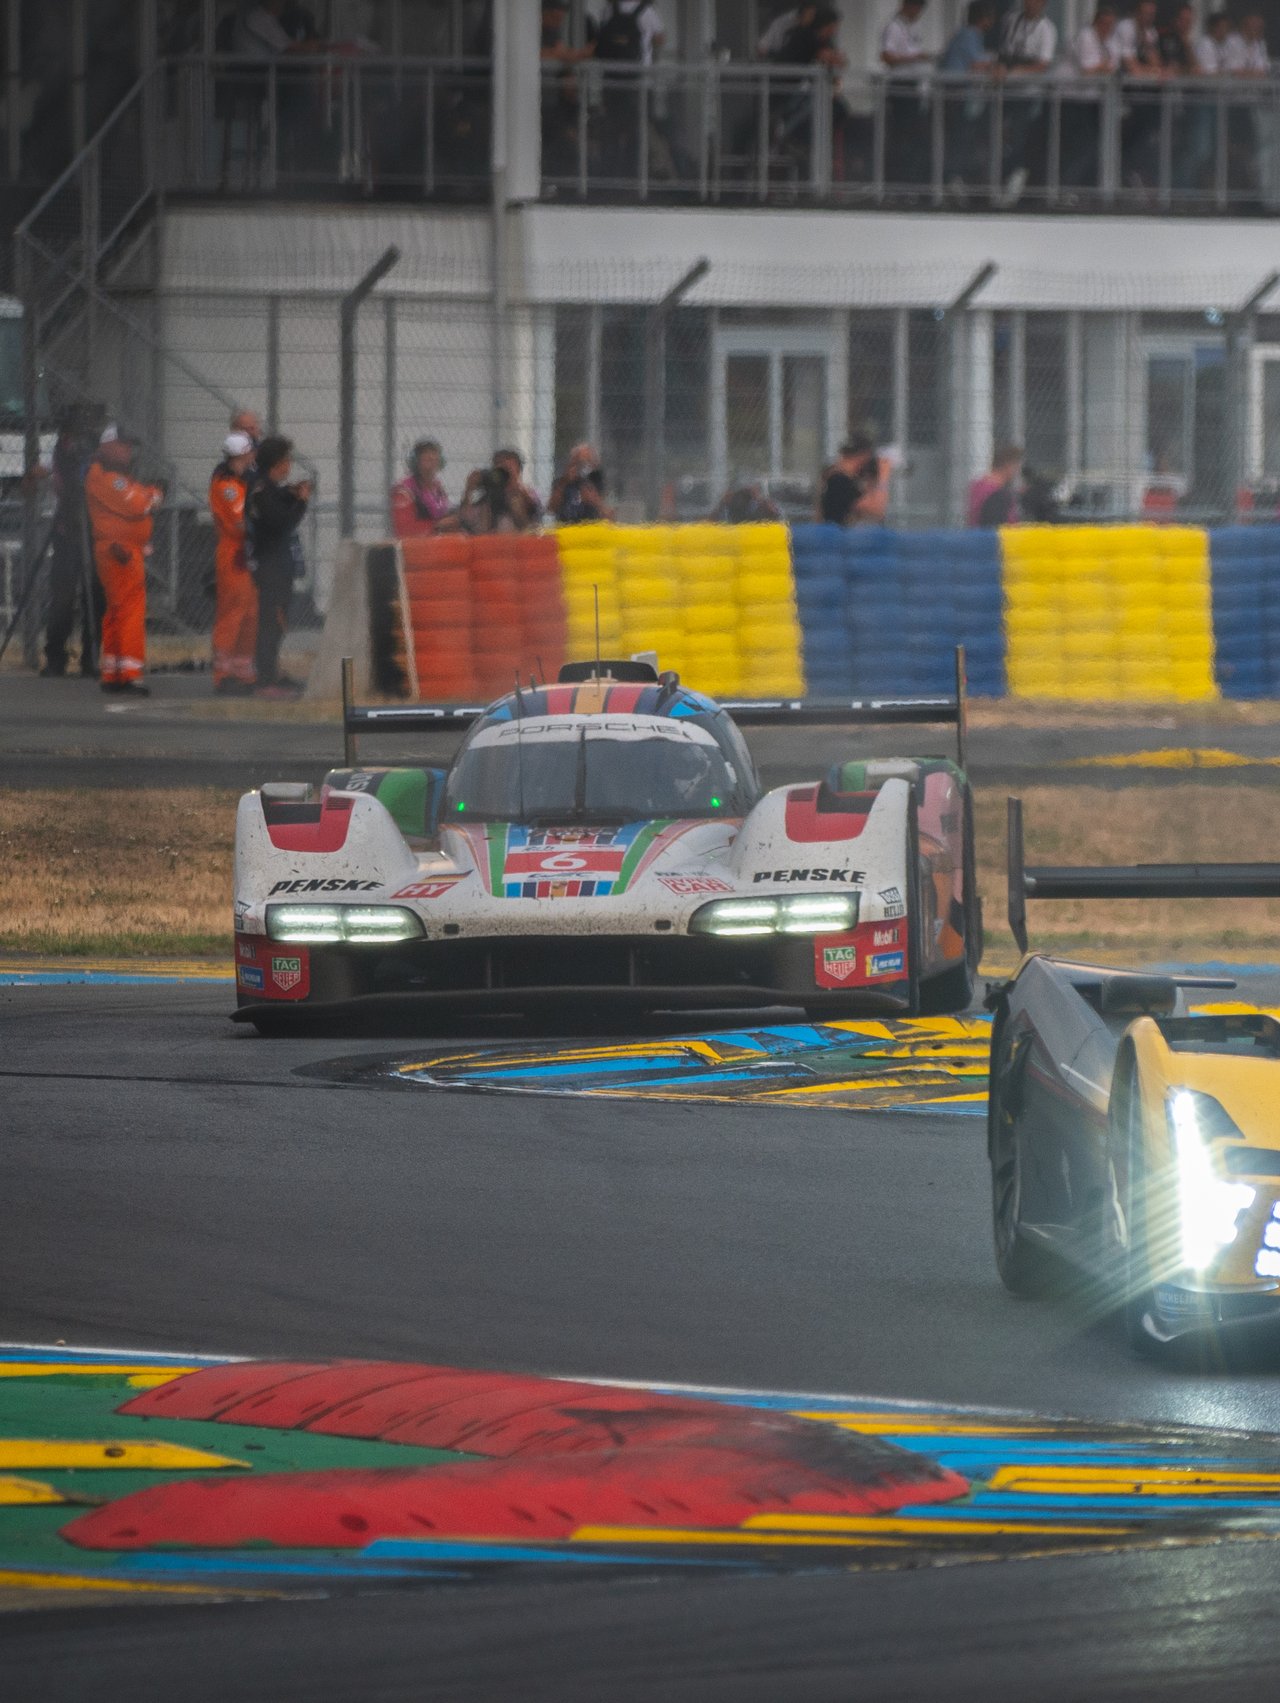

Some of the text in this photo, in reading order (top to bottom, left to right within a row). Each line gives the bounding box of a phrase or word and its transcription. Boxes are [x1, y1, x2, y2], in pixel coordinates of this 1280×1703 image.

[498, 722, 682, 738] PORSCHE
[540, 851, 588, 871] 6
[753, 868, 867, 884] PENSKE
[268, 878, 385, 897] PENSKE
[397, 883, 454, 898] HY
[827, 949, 854, 961] TAG
[274, 960, 299, 971] TAG
[825, 961, 856, 977] HEUER
[272, 972, 300, 988] HEUER
